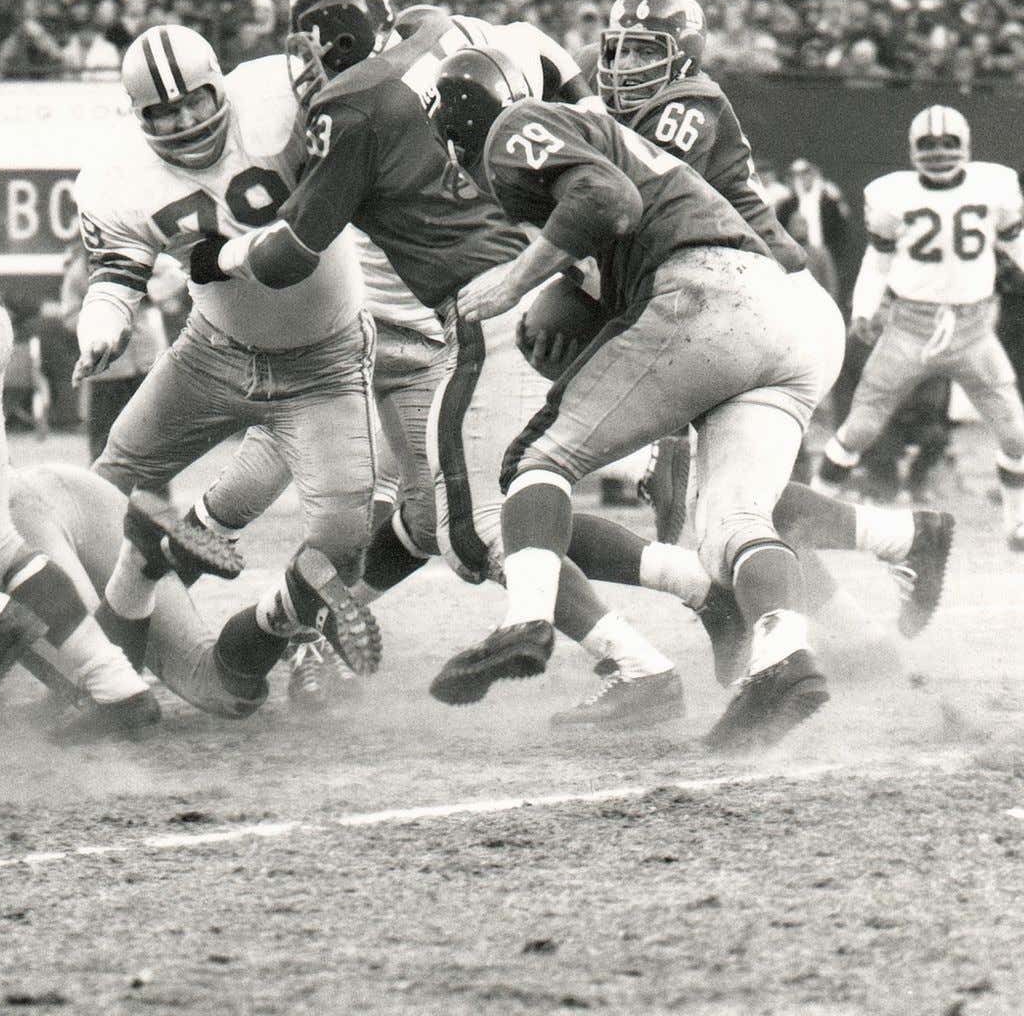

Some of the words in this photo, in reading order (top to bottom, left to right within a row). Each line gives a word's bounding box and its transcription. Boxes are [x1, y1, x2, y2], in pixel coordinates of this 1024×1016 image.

[506, 122, 565, 170] 29
[655, 102, 706, 152] 66
[904, 204, 989, 264] 26
